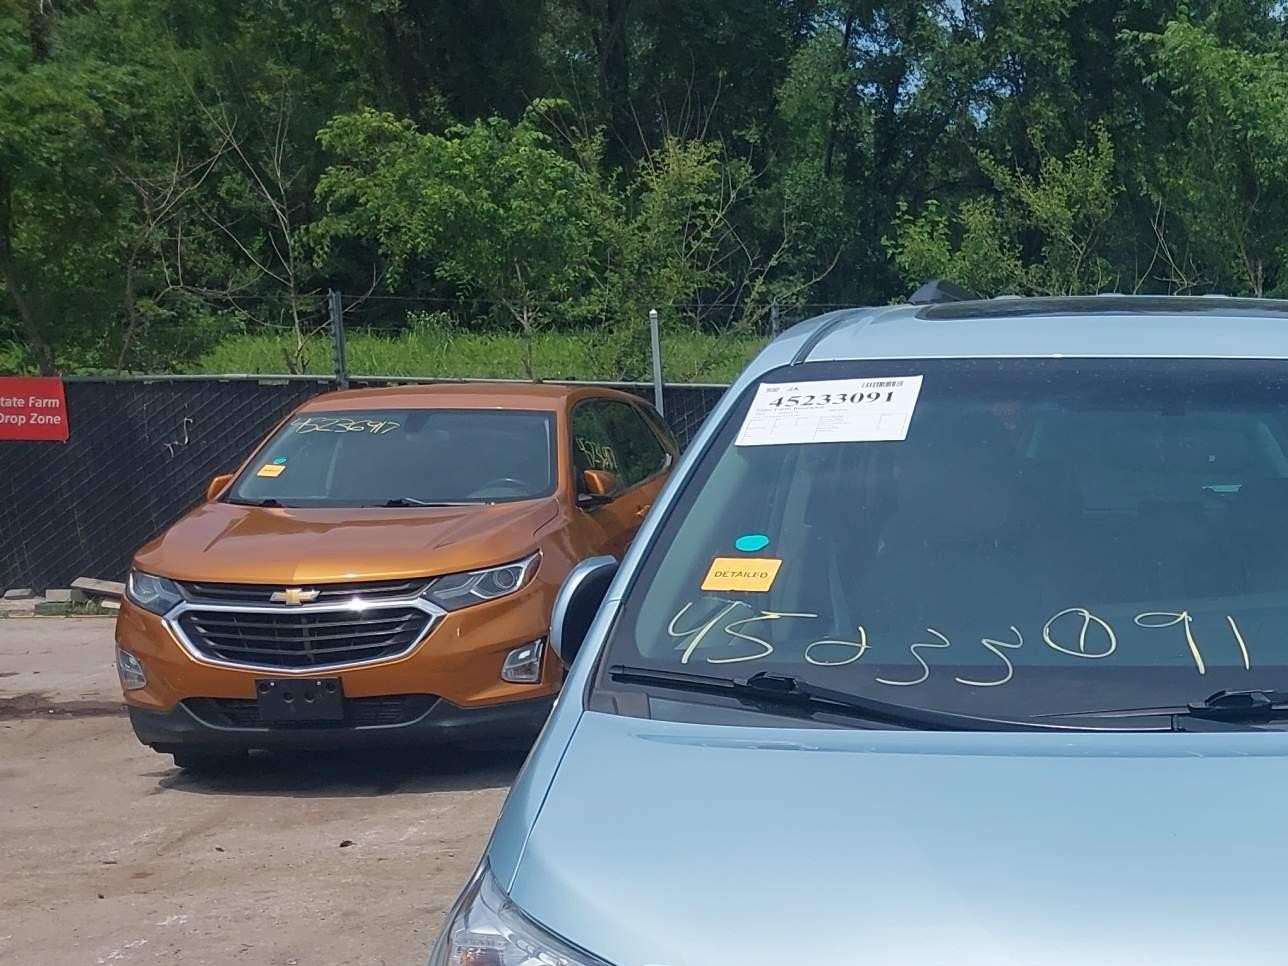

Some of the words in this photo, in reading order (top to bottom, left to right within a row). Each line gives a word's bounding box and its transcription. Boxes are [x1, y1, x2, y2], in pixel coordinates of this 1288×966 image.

[29, 396, 59, 407] Farm
[769, 391, 893, 407] 45233091
[30, 413, 60, 424] Zone
[714, 571, 768, 579] DETAILED
[668, 600, 1251, 686] 45233091
